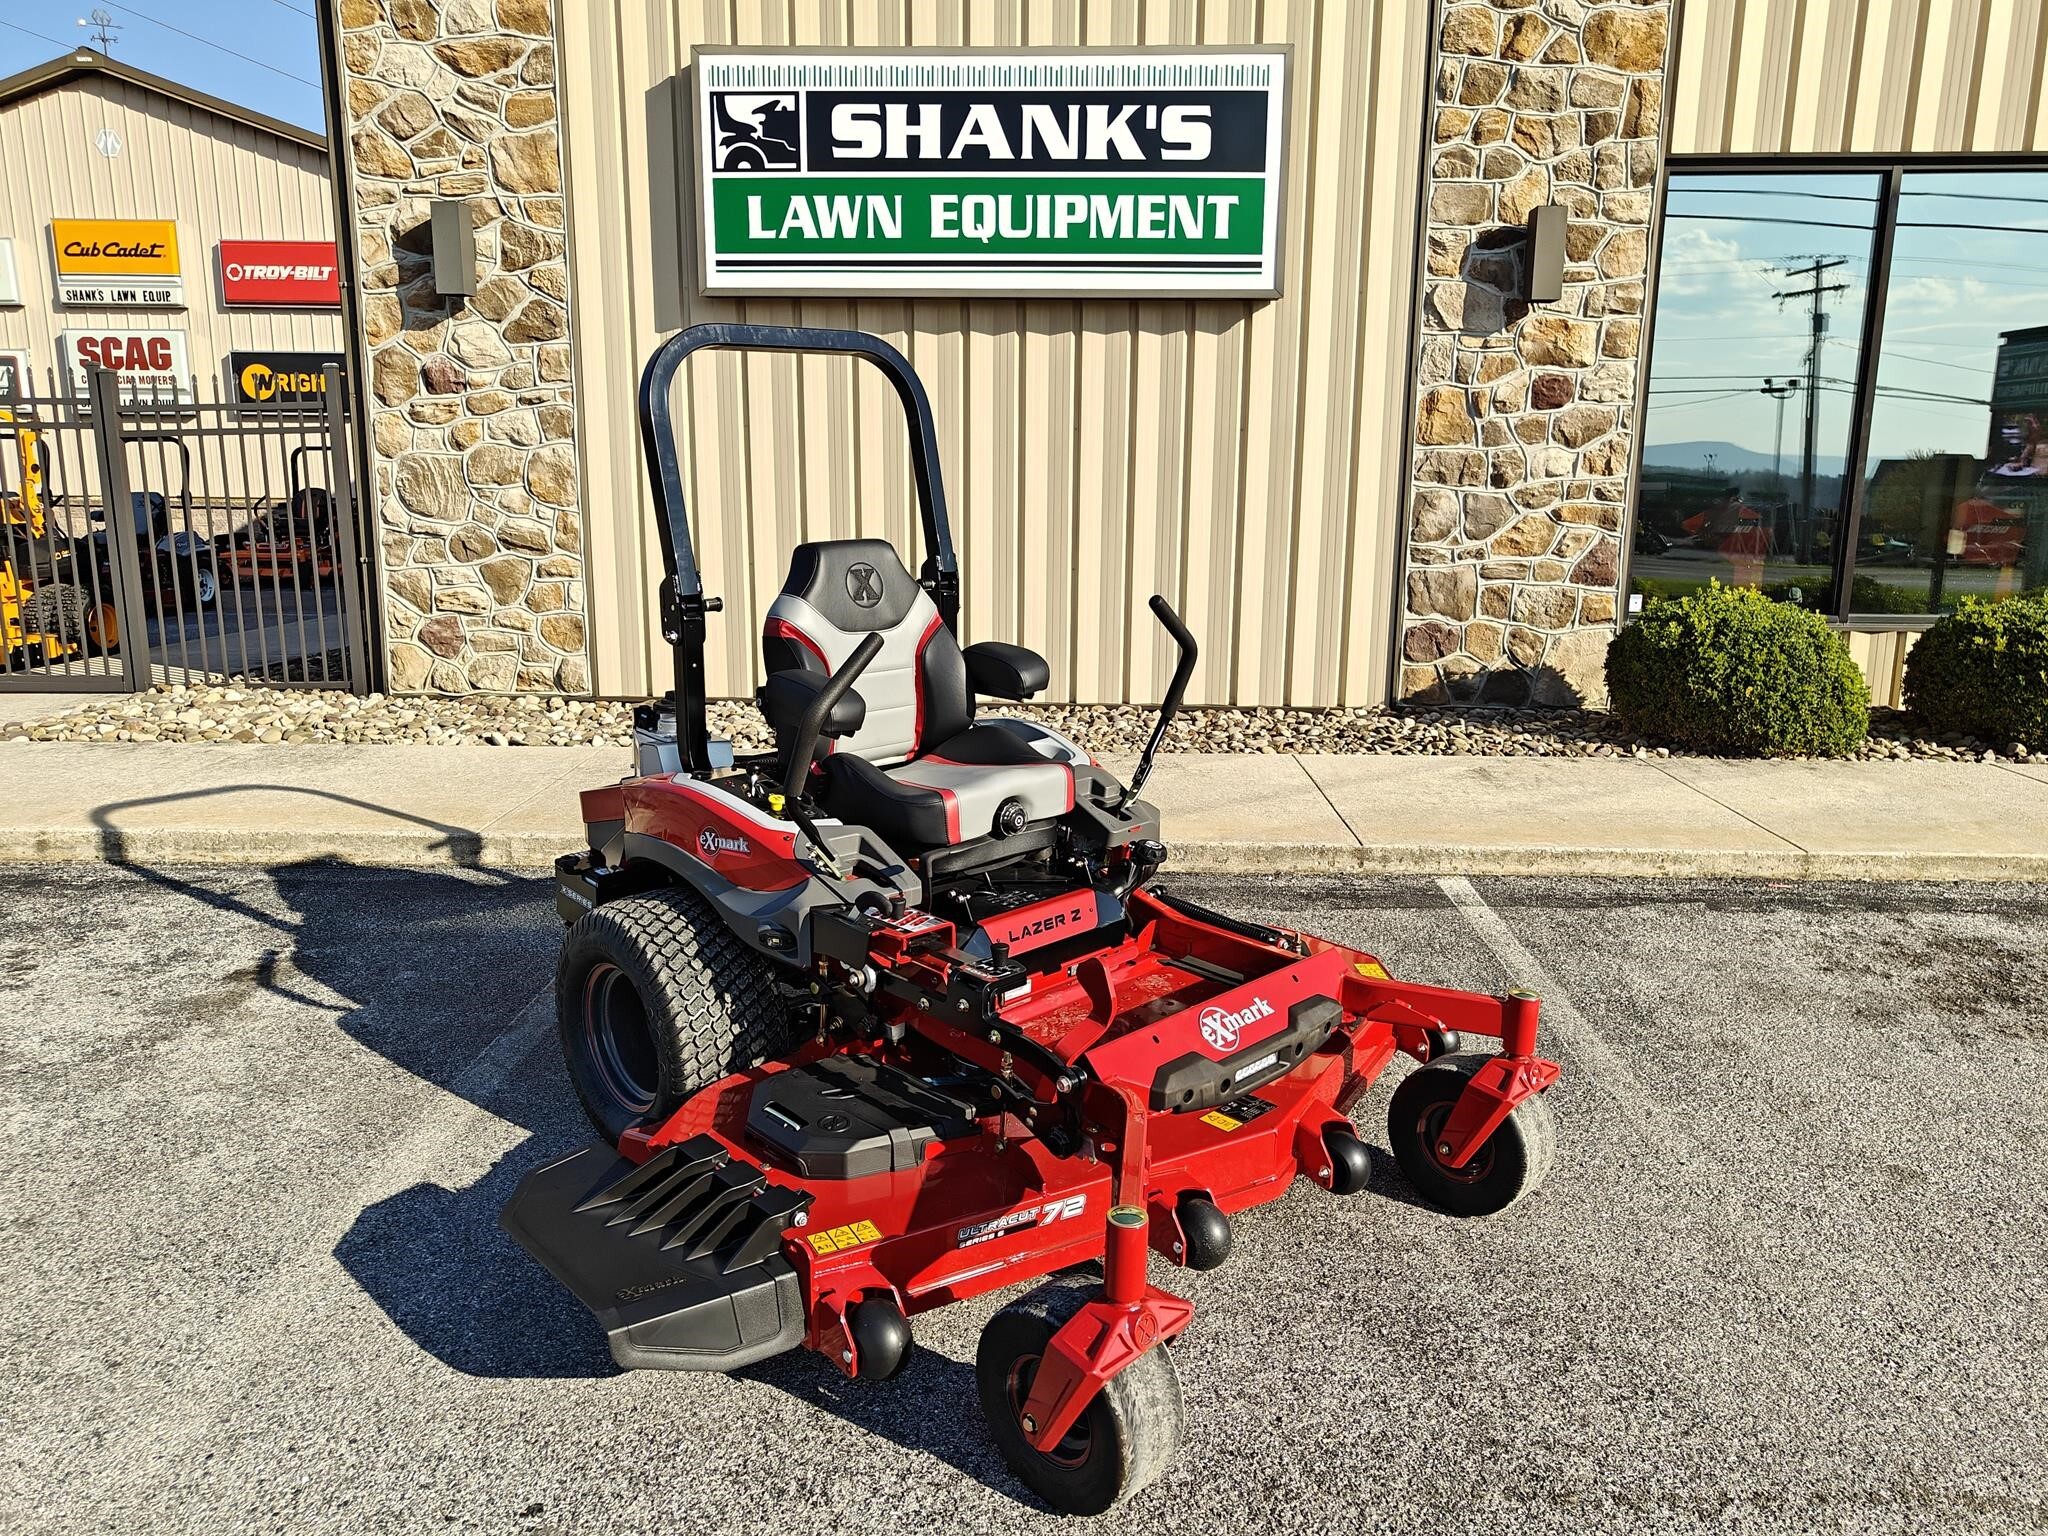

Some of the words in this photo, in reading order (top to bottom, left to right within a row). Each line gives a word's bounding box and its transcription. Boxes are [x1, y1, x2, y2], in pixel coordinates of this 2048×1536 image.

[831, 104, 1213, 161] SHANK'S
[747, 195, 903, 239] LAWN
[930, 195, 1240, 243] EQUIPMENT
[64, 242, 101, 257] Cub
[102, 242, 165, 258] Cadet
[243, 265, 333, 281] TROY-BILT
[66, 289, 104, 302] SHANK'S
[111, 290, 137, 302] LAWN
[77, 337, 172, 370] SCAG
[250, 371, 327, 393] WRIGH
[700, 831, 750, 853] eXmark
[1008, 913, 1066, 942] LAZER
[1070, 908, 1082, 922] Z
[1201, 997, 1275, 1047] eXmark
[957, 1206, 1040, 1240] ULTRACUT
[1039, 1194, 1087, 1227] 72
[958, 1233, 995, 1249] SERIES
